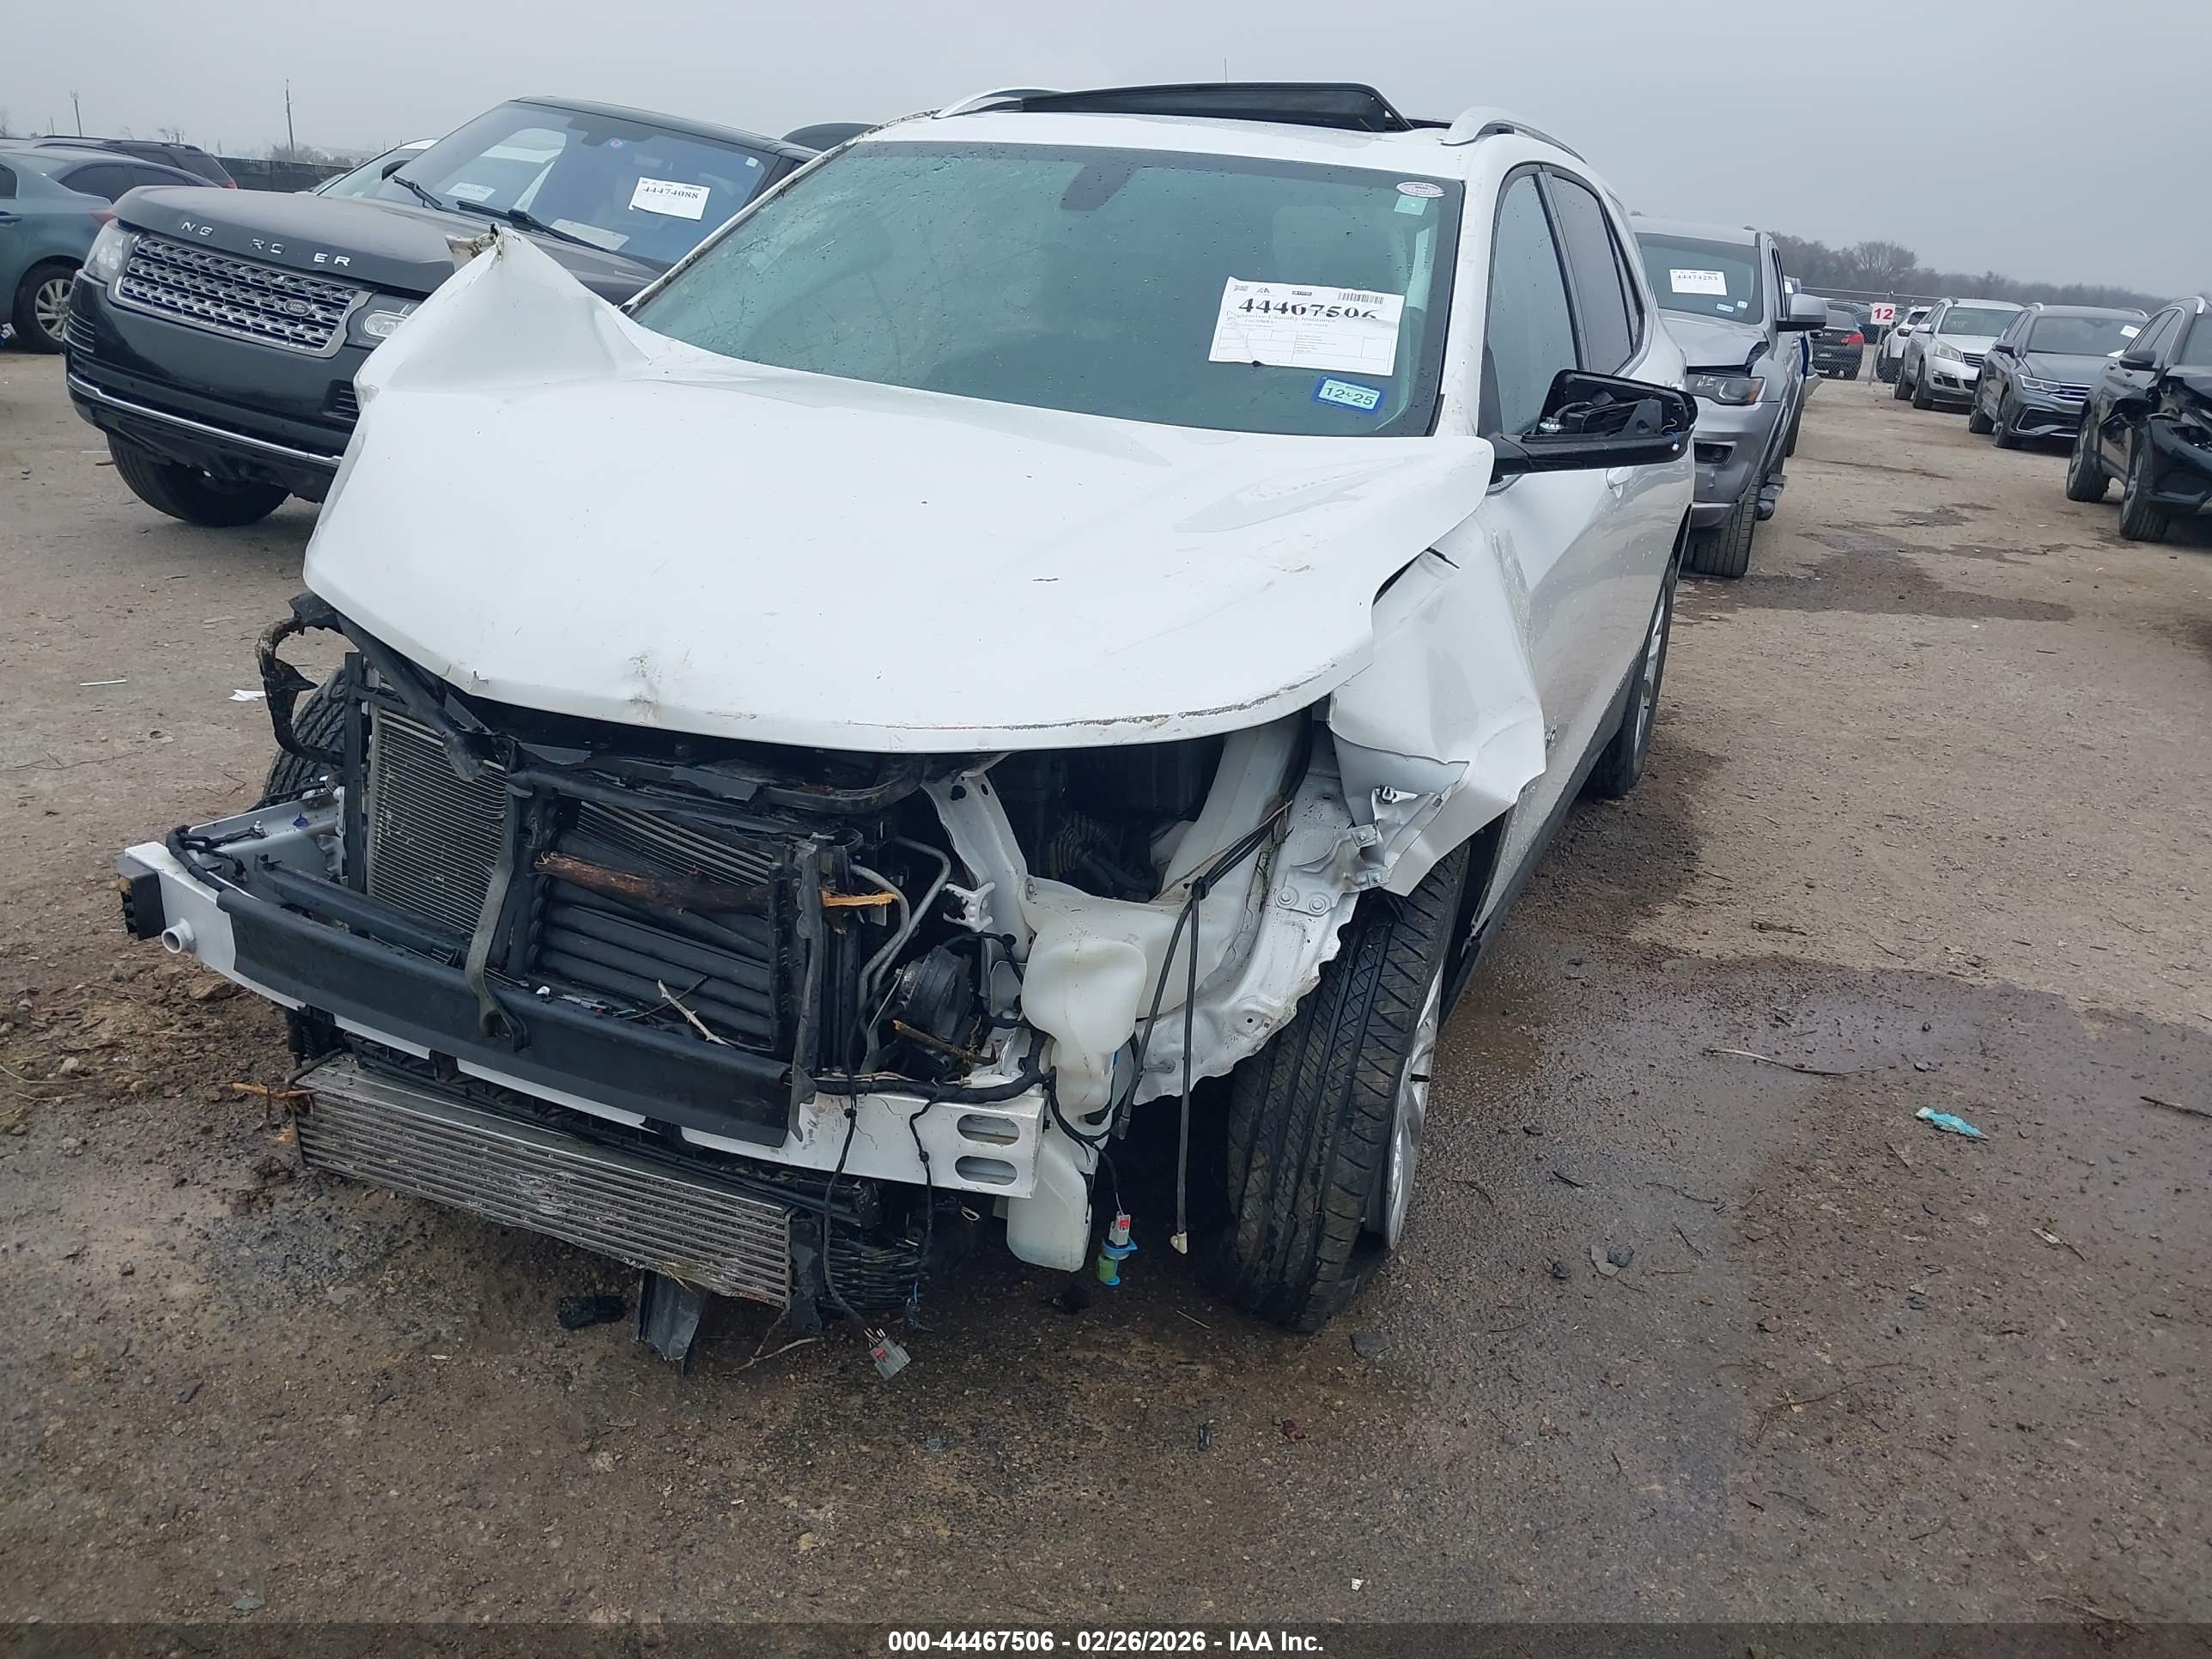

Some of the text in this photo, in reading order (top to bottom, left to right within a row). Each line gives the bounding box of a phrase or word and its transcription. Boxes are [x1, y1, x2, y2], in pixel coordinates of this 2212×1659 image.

[642, 186, 699, 199] 44474088
[1874, 307, 1893, 320] 12
[1326, 386, 1346, 399] 12
[1352, 393, 1375, 406] 25
